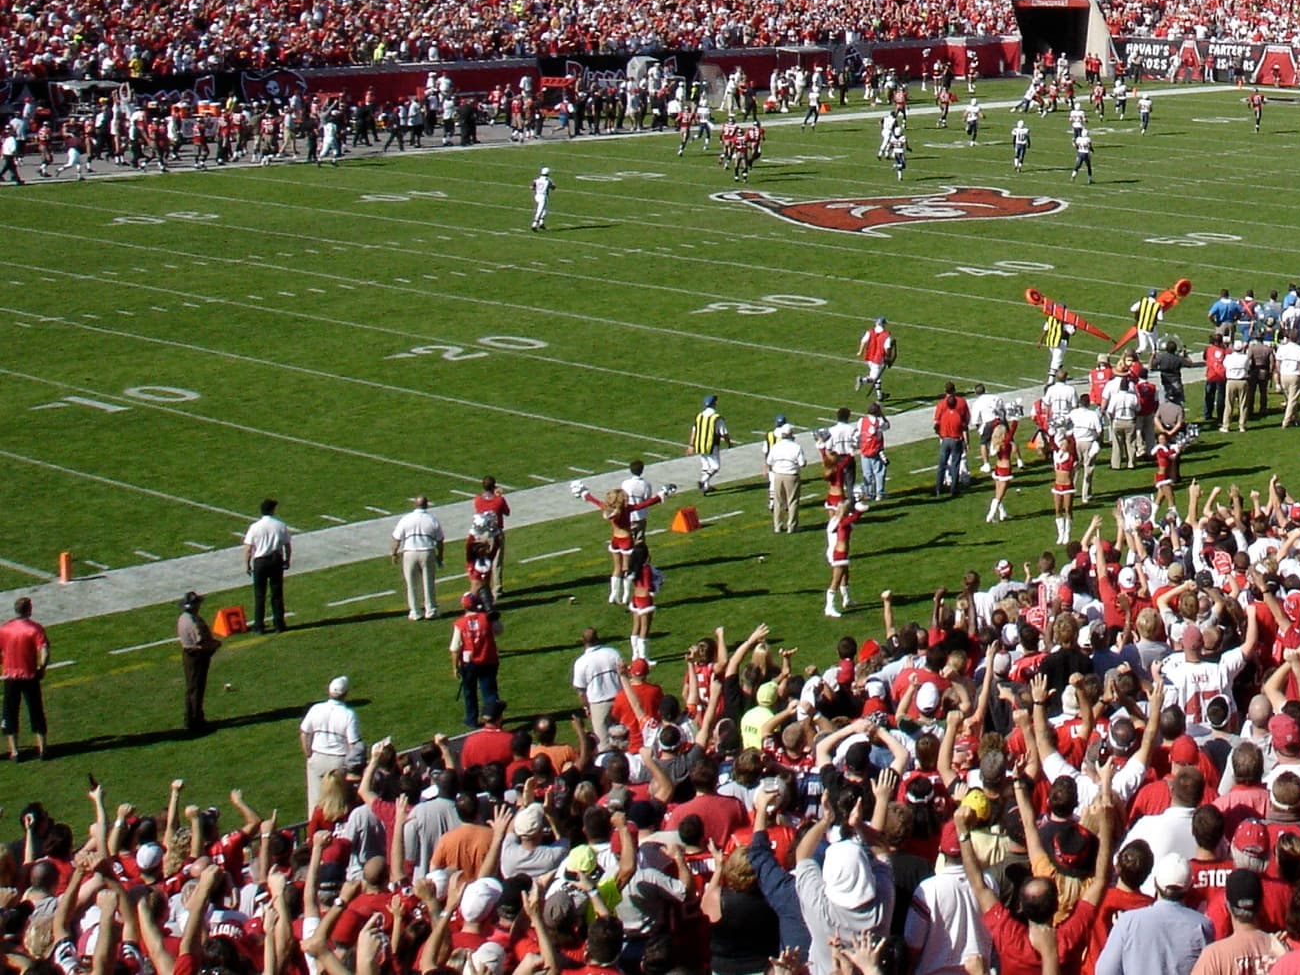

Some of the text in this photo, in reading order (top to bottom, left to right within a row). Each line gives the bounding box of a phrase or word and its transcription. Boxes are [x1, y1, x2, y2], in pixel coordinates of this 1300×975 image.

[705, 294, 829, 315] 30
[408, 335, 549, 361] 20
[63, 385, 201, 414] 10
